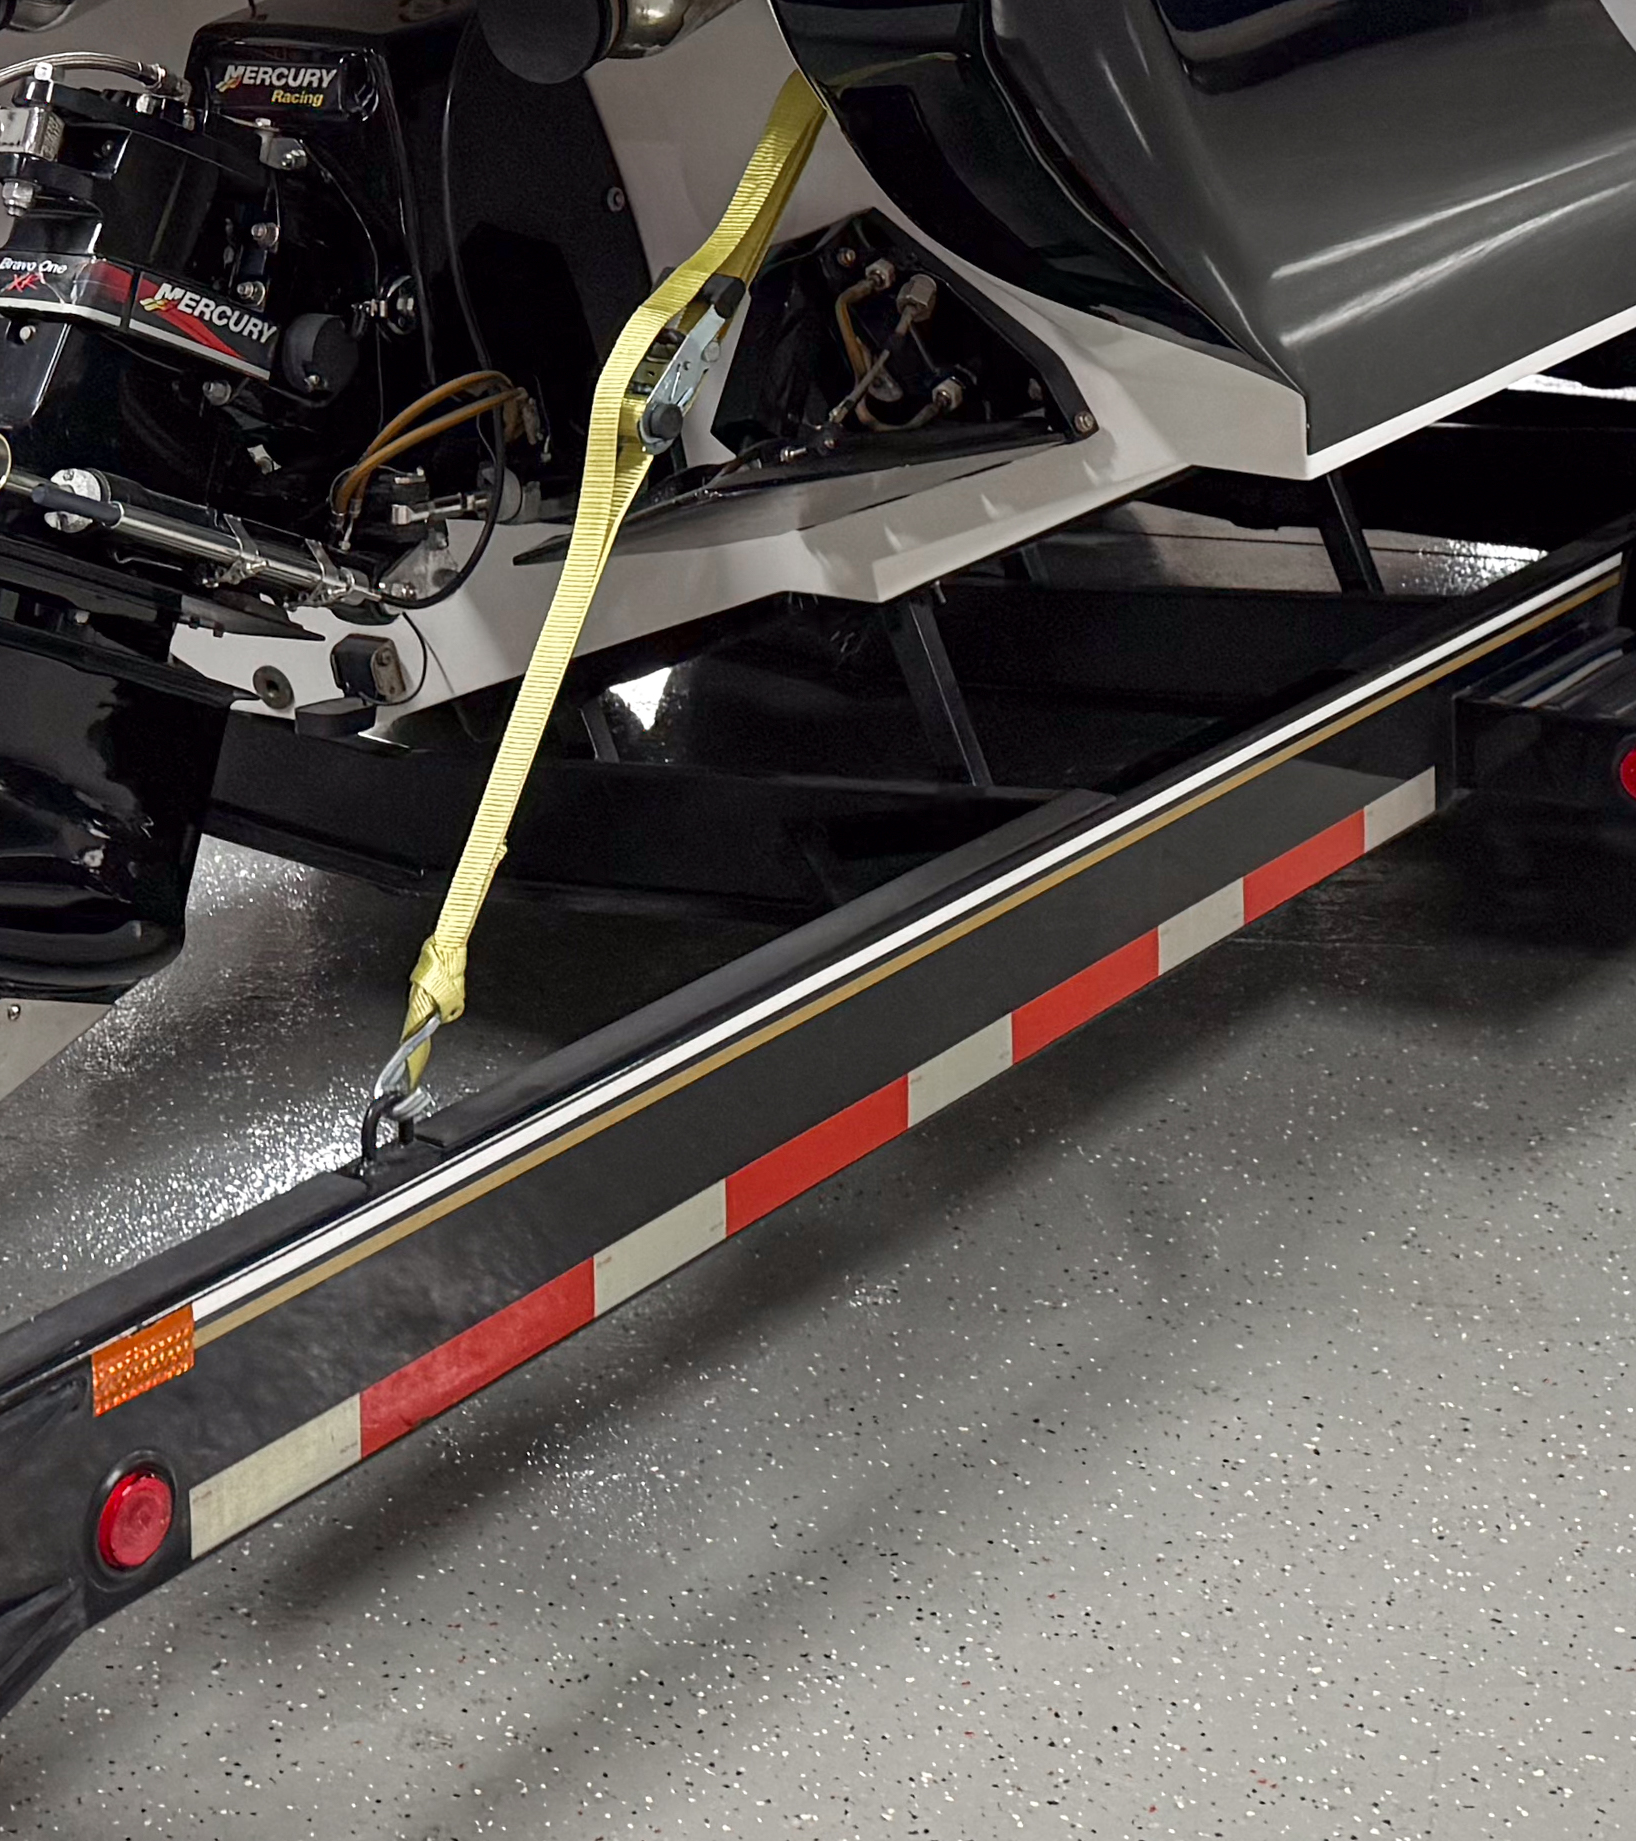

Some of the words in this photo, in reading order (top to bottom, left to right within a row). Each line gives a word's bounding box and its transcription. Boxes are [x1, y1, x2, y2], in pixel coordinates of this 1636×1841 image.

[220, 64, 338, 90] MERCURY
[271, 89, 324, 107] Racing
[0, 257, 37, 271] Bravo
[38, 259, 68, 274] One
[151, 282, 278, 344] MERCURY
